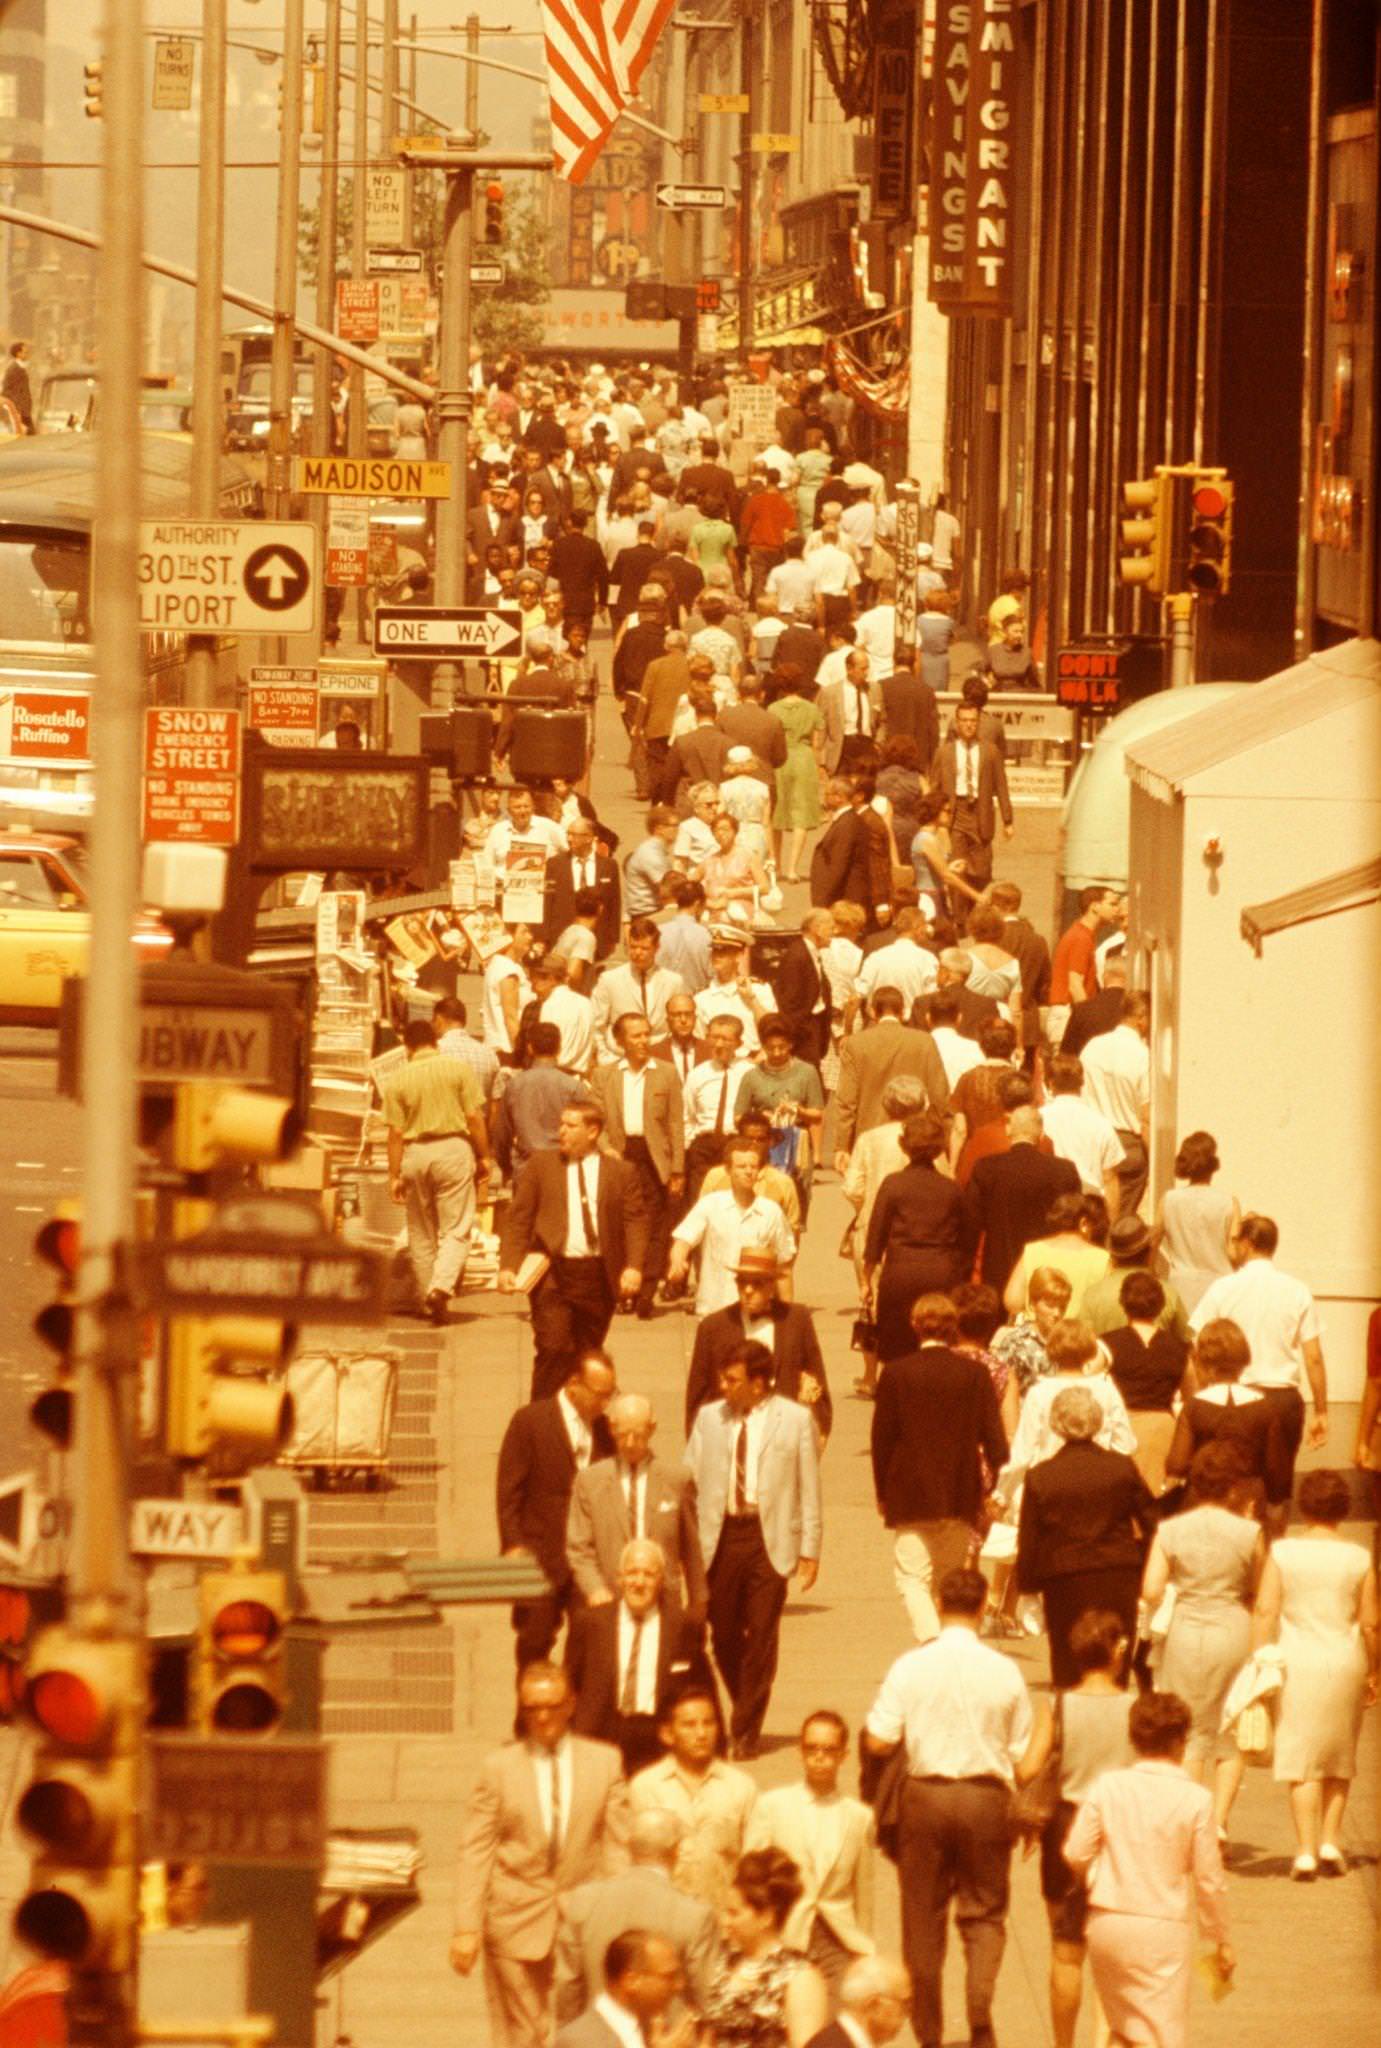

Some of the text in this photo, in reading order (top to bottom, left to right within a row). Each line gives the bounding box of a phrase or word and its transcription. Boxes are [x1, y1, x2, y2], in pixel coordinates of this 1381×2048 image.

[167, 47, 183, 60] NO
[943, 5, 971, 251] SAVINGS
[373, 176, 393, 187] NO
[367, 189, 398, 200] LEFT
[367, 202, 400, 214] TURN
[304, 462, 446, 491] MADISON AVE
[152, 526, 240, 545] AUTHORITY
[338, 551, 356, 562] NO
[201, 556, 237, 585] ST.
[138, 594, 237, 625] LIPORT
[386, 623, 501, 642] ONE WAY
[320, 675, 374, 690] EPHONE
[1060, 680, 1118, 703] WALK
[254, 691, 314, 706] NO STANDING
[13, 706, 86, 728] Rosatello
[158, 712, 228, 732] SNOW
[19, 726, 70, 744] Ruffino
[156, 733, 229, 747] EMERGENCY
[152, 748, 231, 769] STREET
[148, 780, 233, 796] NO STANDING
[145, 1511, 225, 1548] WAY
